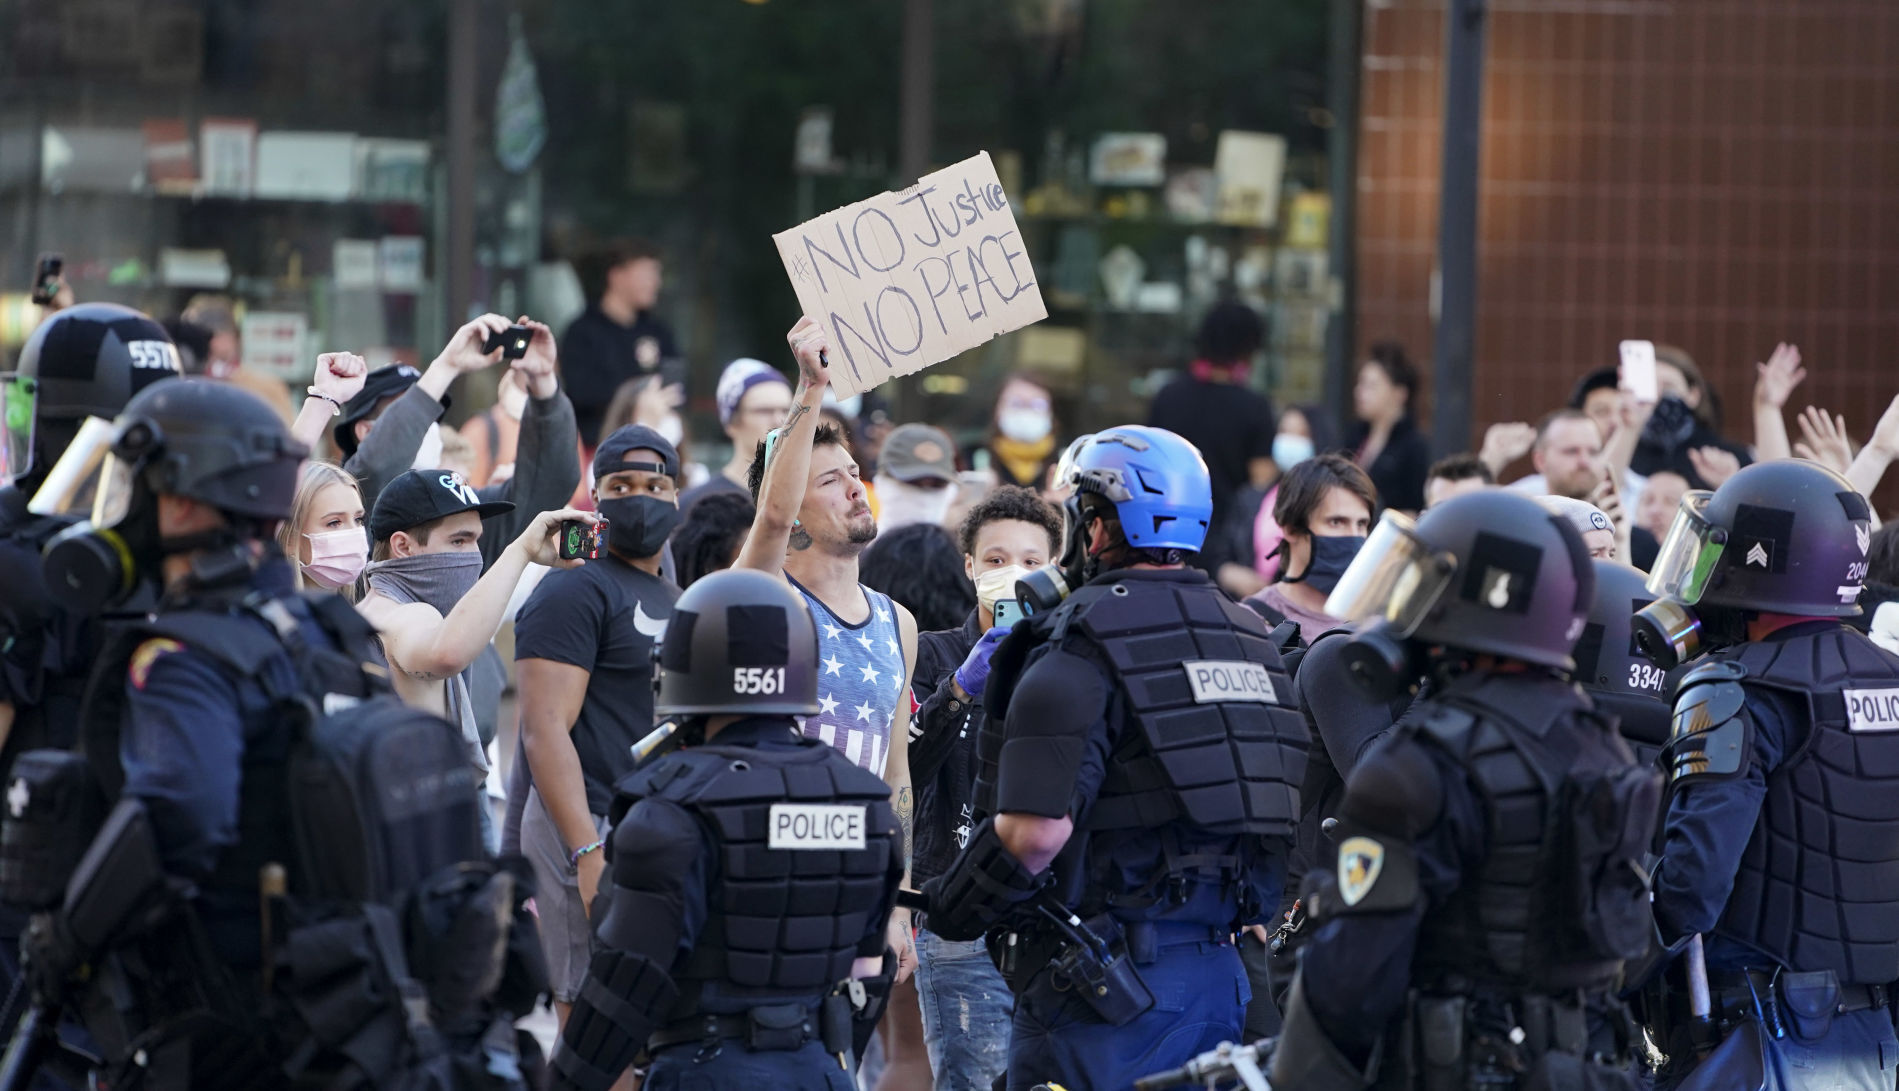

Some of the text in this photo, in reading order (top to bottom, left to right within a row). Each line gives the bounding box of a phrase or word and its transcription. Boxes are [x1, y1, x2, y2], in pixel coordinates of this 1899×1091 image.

[830, 230, 1035, 383] NO PEACE
[733, 667, 785, 694] 5561
[1196, 668, 1271, 694] POLICE
[1628, 663, 1666, 692] 3347
[777, 814, 859, 840] POLICE
